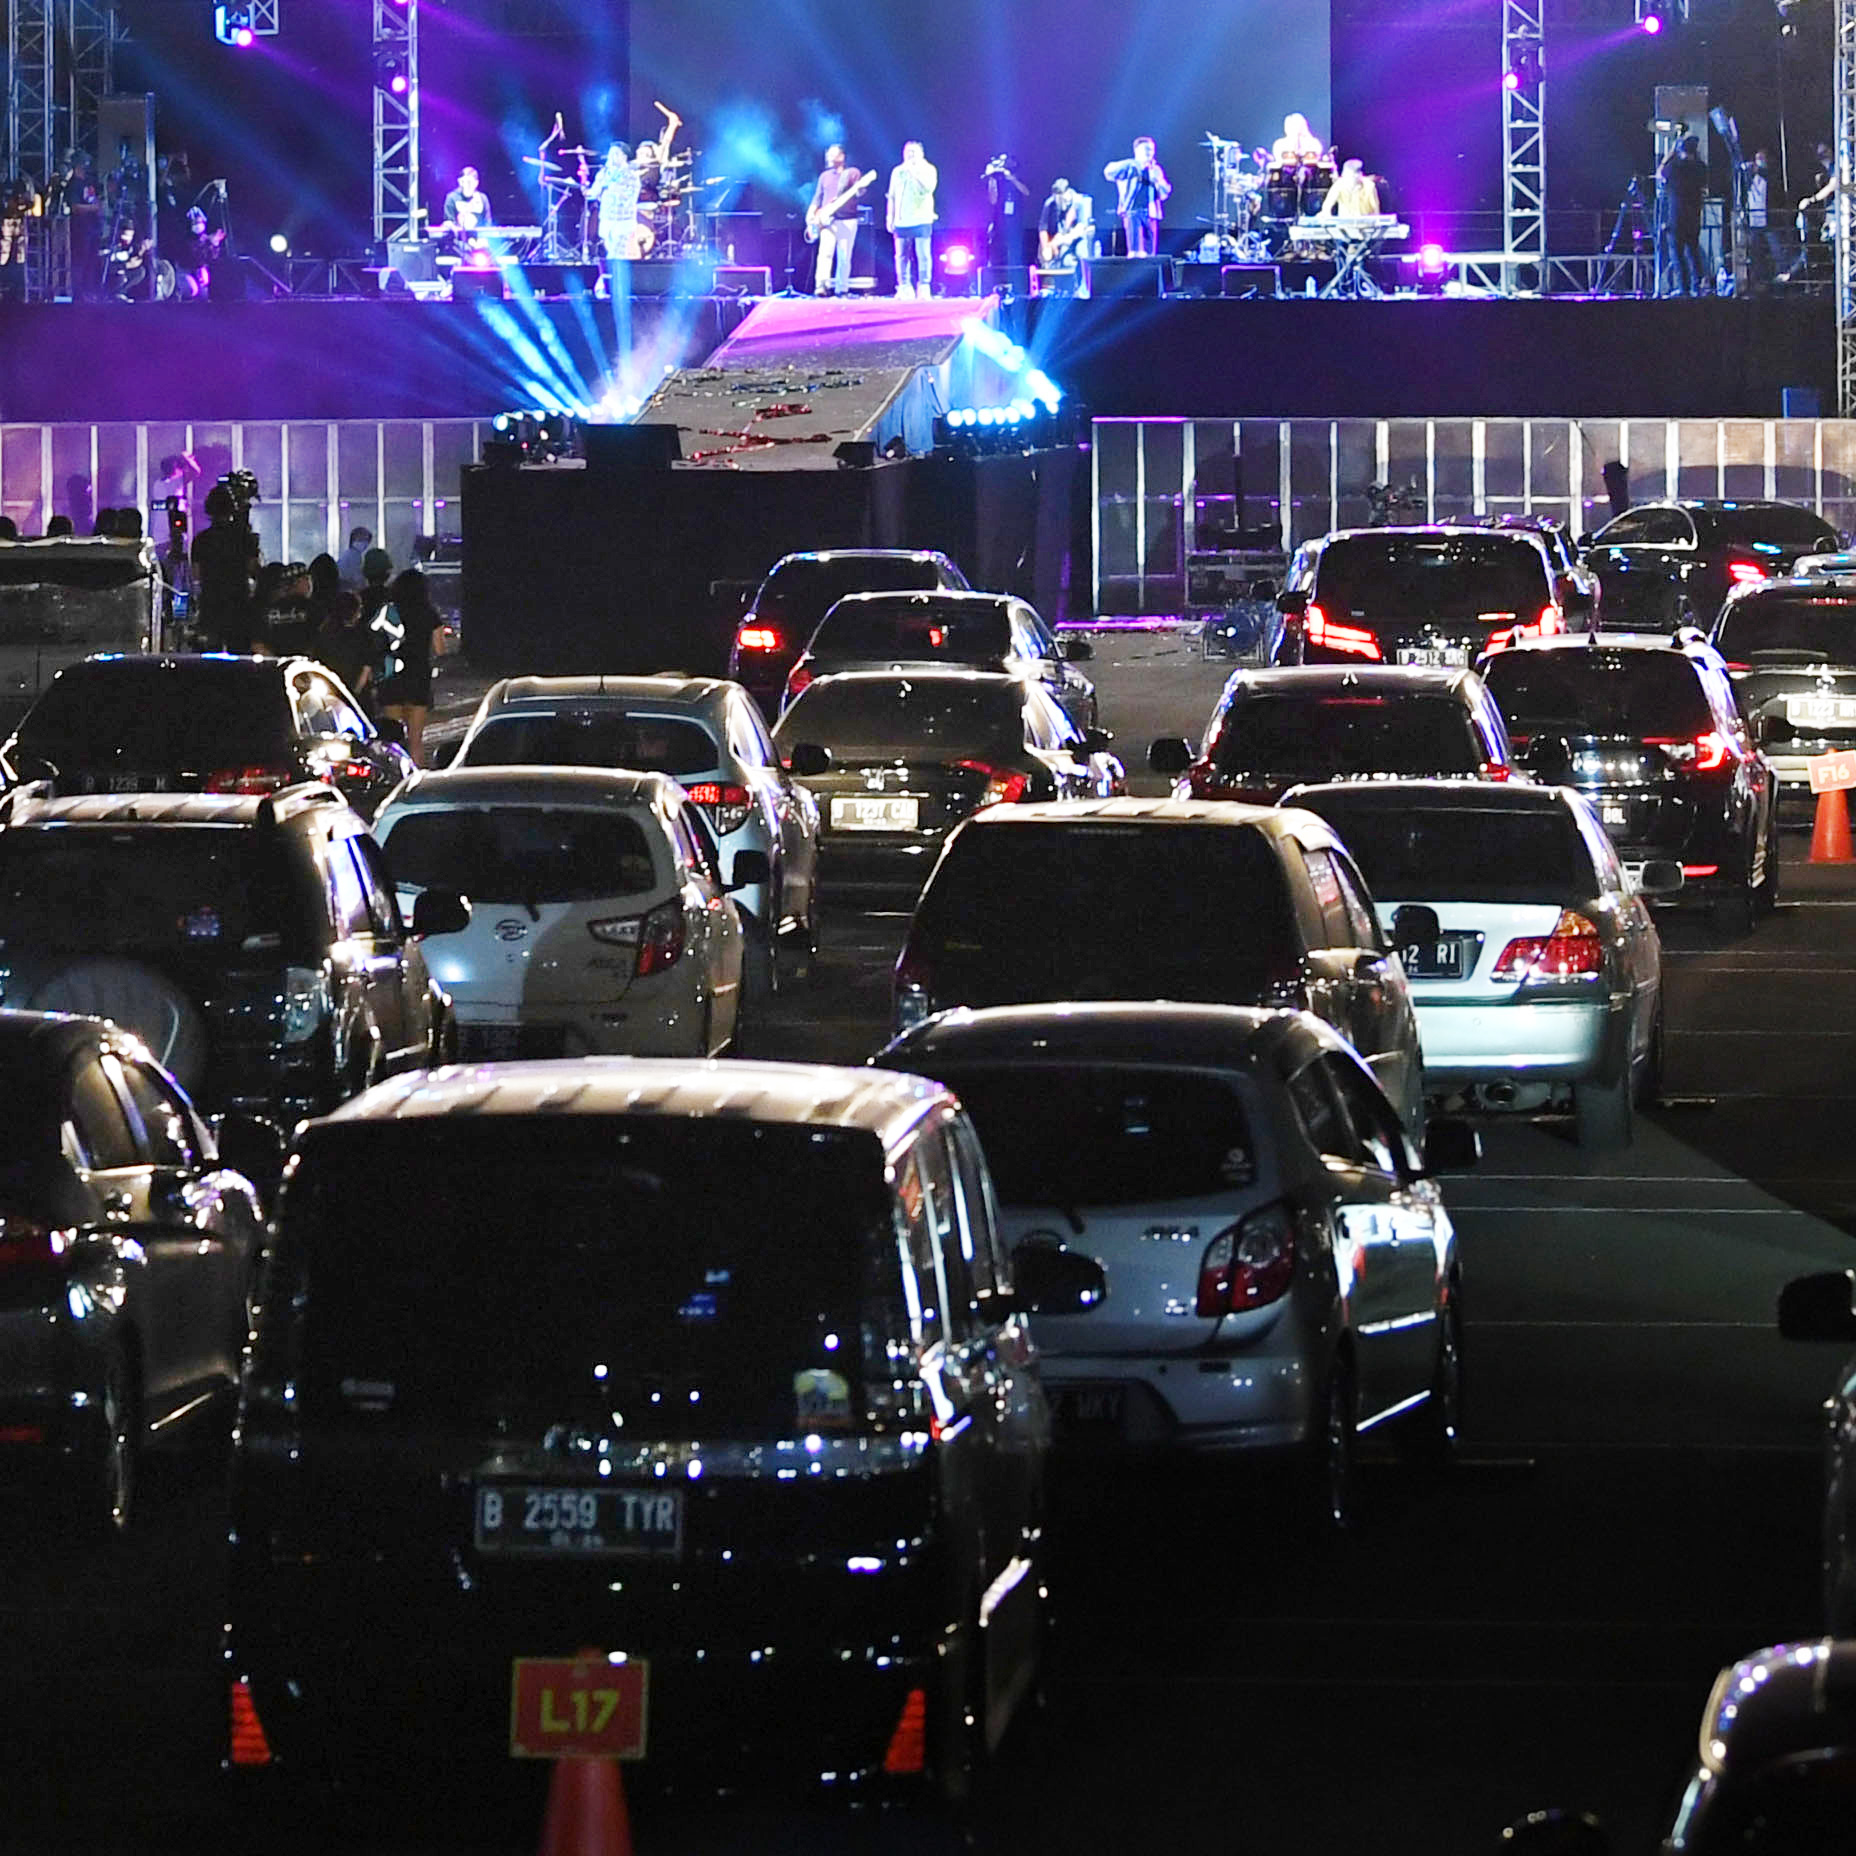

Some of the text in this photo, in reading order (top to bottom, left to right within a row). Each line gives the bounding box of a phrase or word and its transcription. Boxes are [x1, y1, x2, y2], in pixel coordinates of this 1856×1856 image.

[1818, 764, 1850, 784] F16
[1437, 943, 1456, 964] RI
[484, 1492, 675, 1532] B 2559 TYR
[541, 1688, 619, 1733] L17
